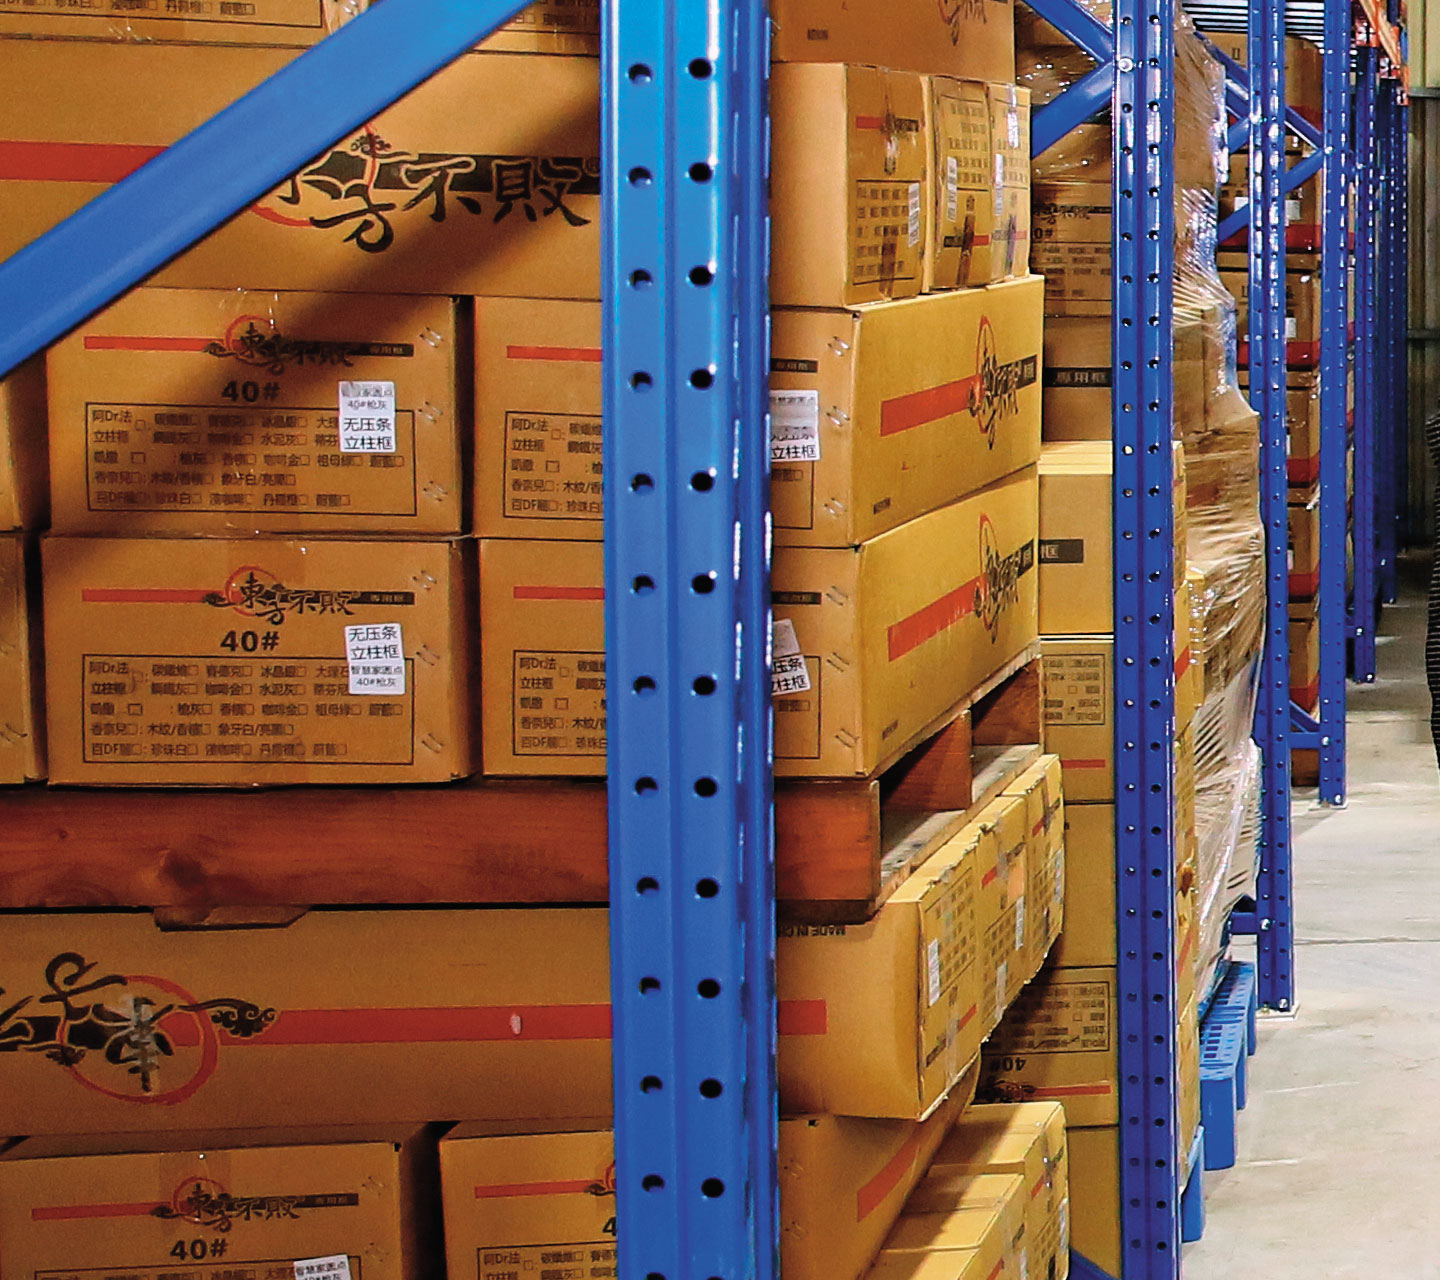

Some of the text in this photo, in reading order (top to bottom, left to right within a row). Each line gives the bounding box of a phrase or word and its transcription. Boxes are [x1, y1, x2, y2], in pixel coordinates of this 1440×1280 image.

[222, 381, 280, 403] 40#
[344, 418, 392, 431] 无压条
[344, 437, 392, 450] 立柱框
[772, 445, 817, 460] 立柱框
[220, 630, 280, 652] 40#
[349, 626, 398, 642] 无压条
[351, 646, 399, 660] 立柱框
[170, 1238, 229, 1260] 40#
